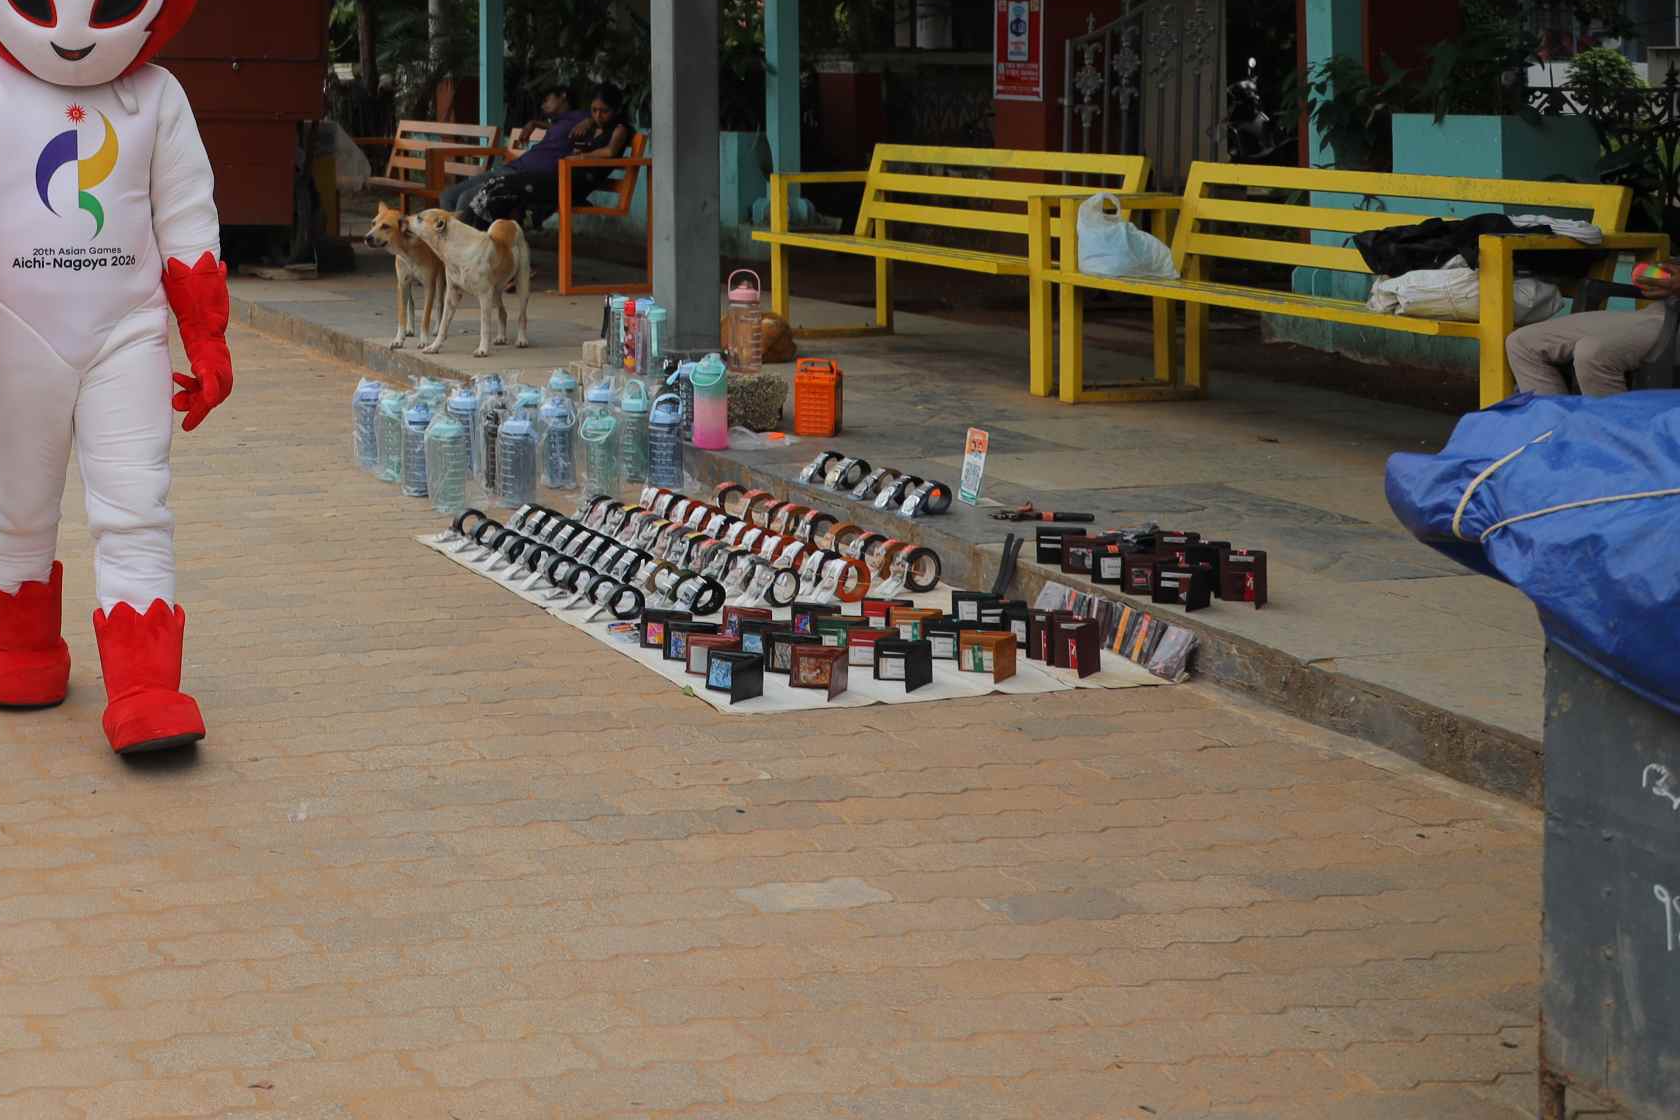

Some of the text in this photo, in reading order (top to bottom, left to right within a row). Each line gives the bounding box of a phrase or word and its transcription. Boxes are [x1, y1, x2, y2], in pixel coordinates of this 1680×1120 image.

[32, 246, 122, 256] 20th Asian Games
[12, 255, 136, 271] Aichi-Nagoya 2026
